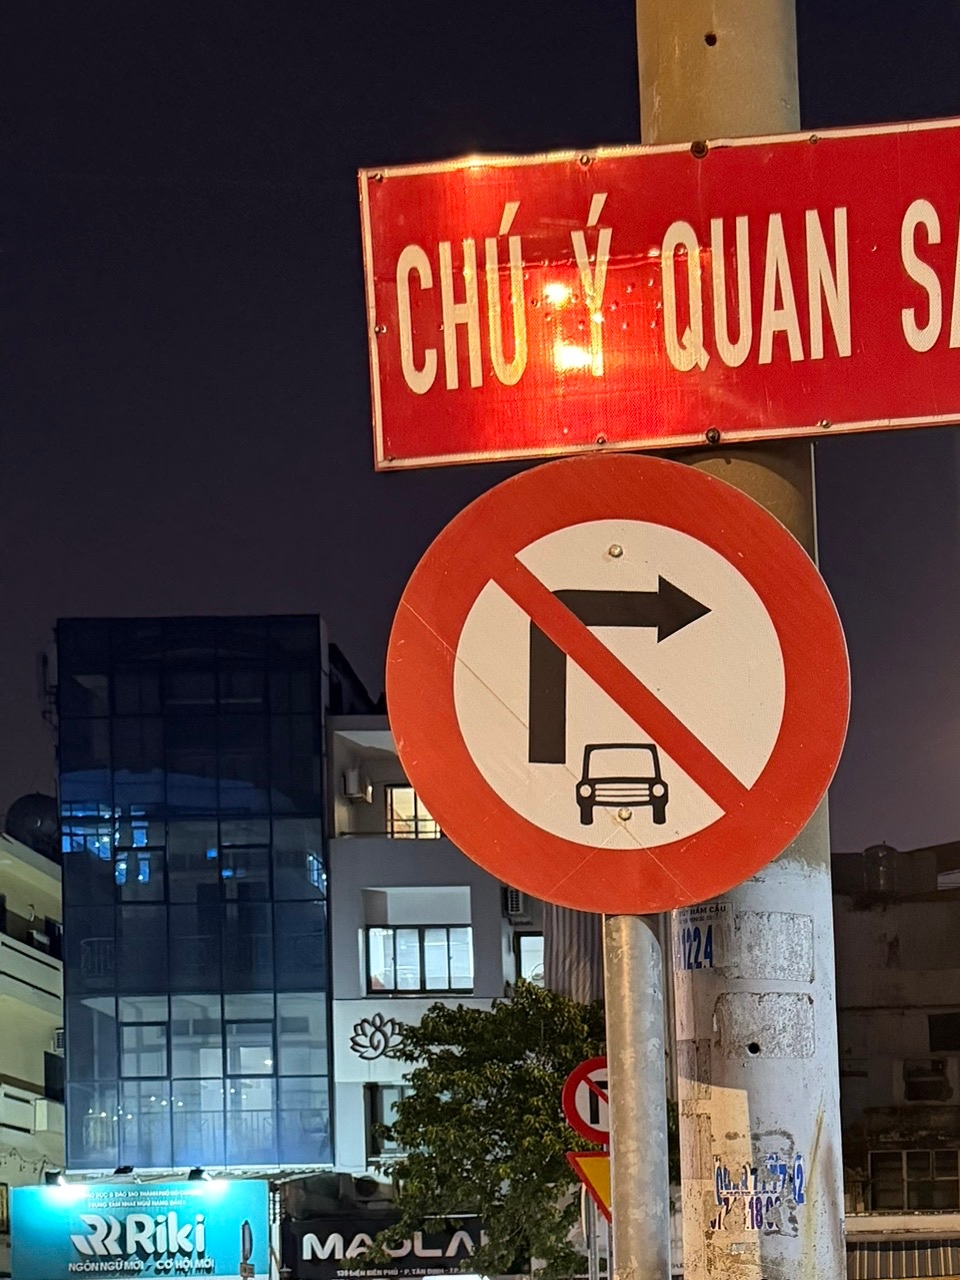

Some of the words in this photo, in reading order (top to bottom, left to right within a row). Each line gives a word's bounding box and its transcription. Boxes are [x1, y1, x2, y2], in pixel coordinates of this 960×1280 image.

[397, 202, 528, 395] CHÚ
[571, 193, 613, 377] Ý
[661, 206, 853, 372] QUAN
[126, 1211, 206, 1255] Riki
[68, 1258, 100, 1272] NGÔN
[100, 1257, 123, 1271] NGỮ
[124, 1256, 144, 1270] MỚI
[156, 1257, 173, 1269] CƠ
[175, 1257, 193, 1272] HỘI
[195, 1256, 215, 1270] MỚI
